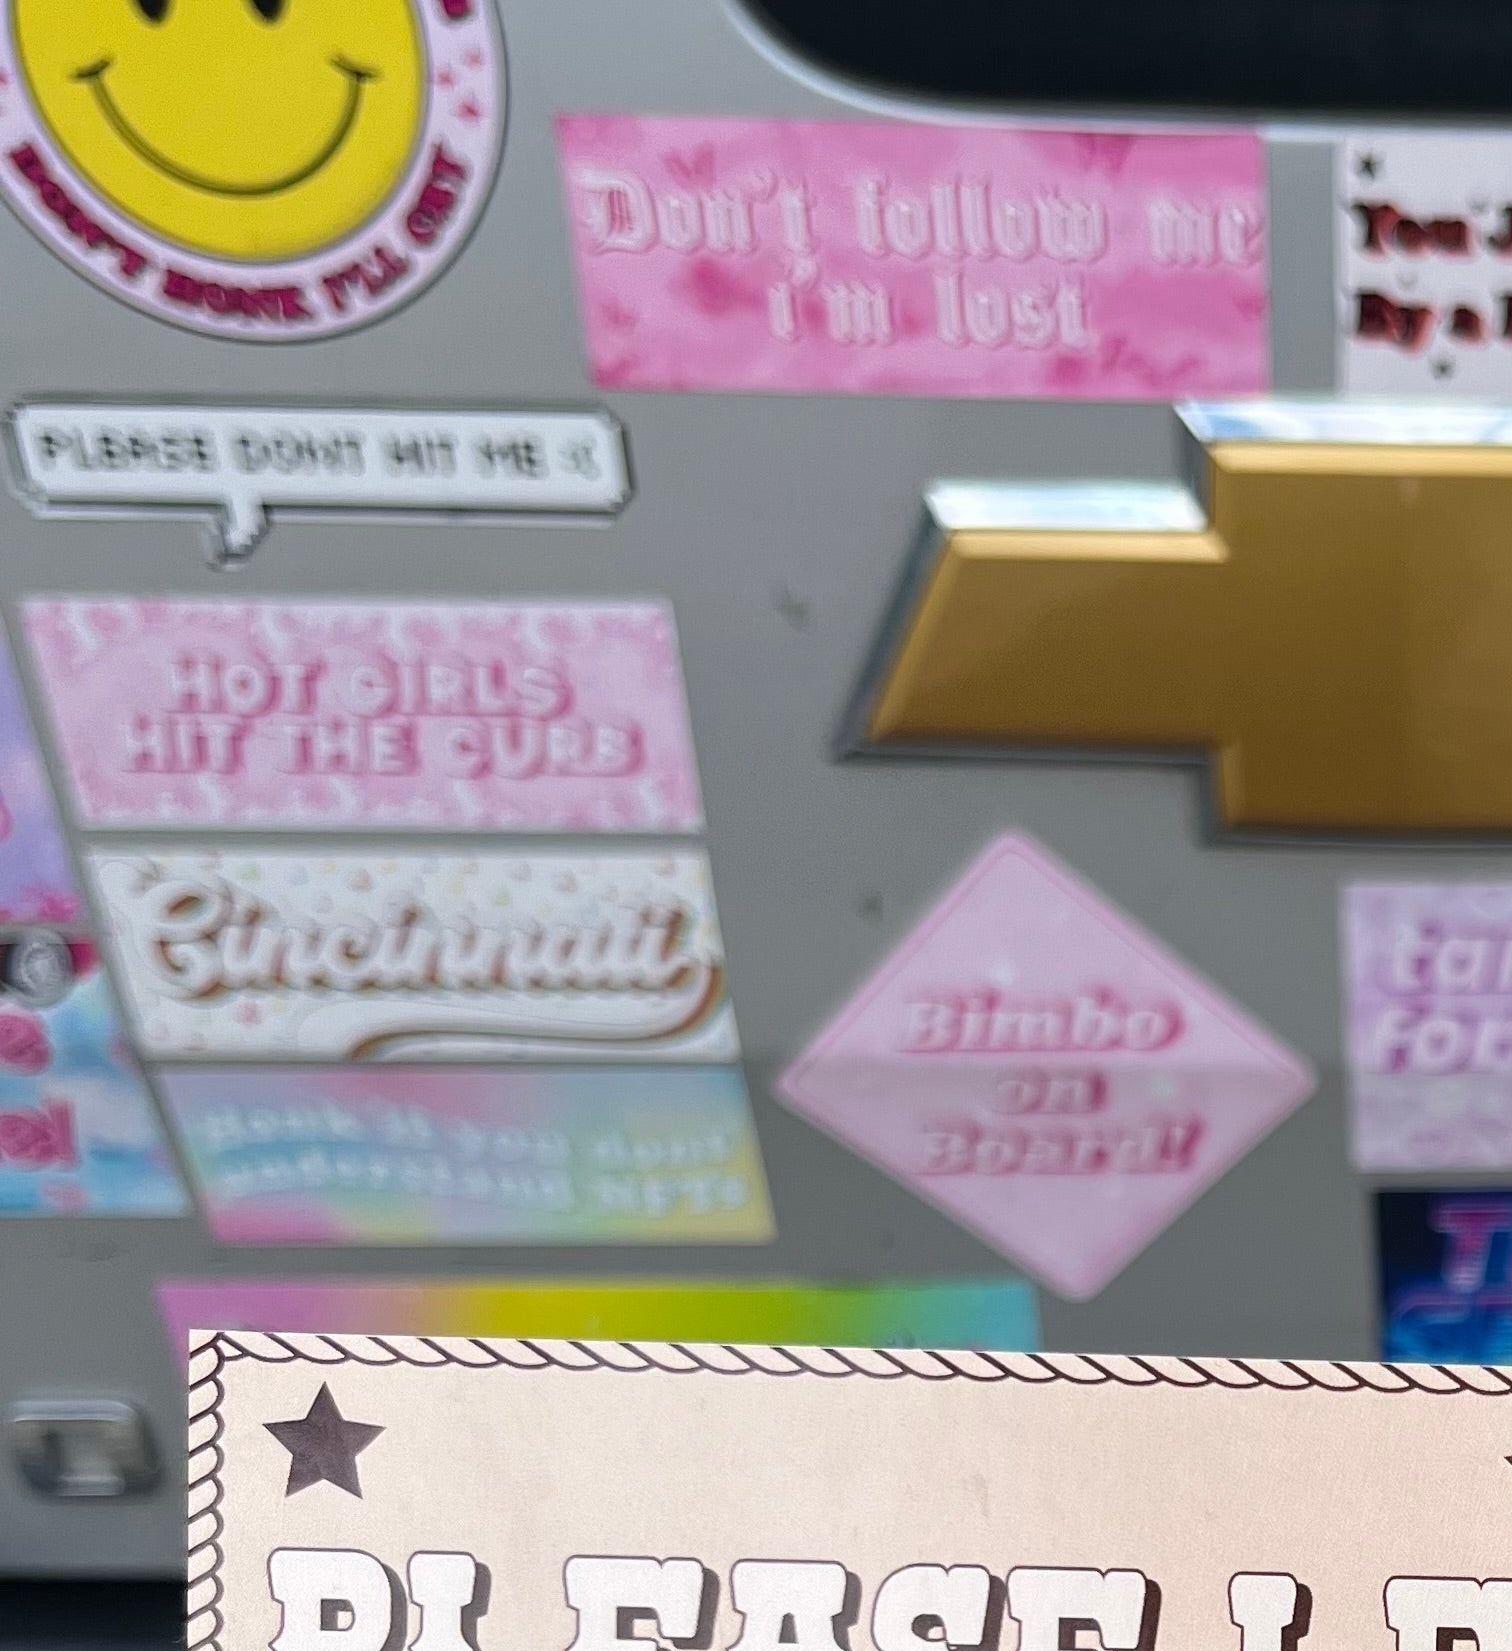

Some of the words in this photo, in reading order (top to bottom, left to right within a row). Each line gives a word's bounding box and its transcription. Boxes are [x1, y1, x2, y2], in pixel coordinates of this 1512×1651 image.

[571, 164, 822, 256] Don't
[852, 172, 1109, 264] follow
[1143, 190, 1267, 270] me
[1350, 200, 1479, 260] You
[930, 268, 1096, 352] lost
[1353, 290, 1435, 356] By
[1447, 302, 1487, 345] a
[37, 428, 222, 474] PLEASE
[378, 428, 460, 478] HIT
[470, 432, 552, 480] ME
[165, 659, 327, 718] HOT
[343, 659, 574, 722] GIRLS
[121, 713, 249, 775] HIT
[280, 720, 420, 777] THE
[442, 720, 646, 779] CURB
[138, 875, 722, 1003] Cincinnati
[899, 985, 1187, 1053] Bimbo
[991, 1073, 1109, 1115] on
